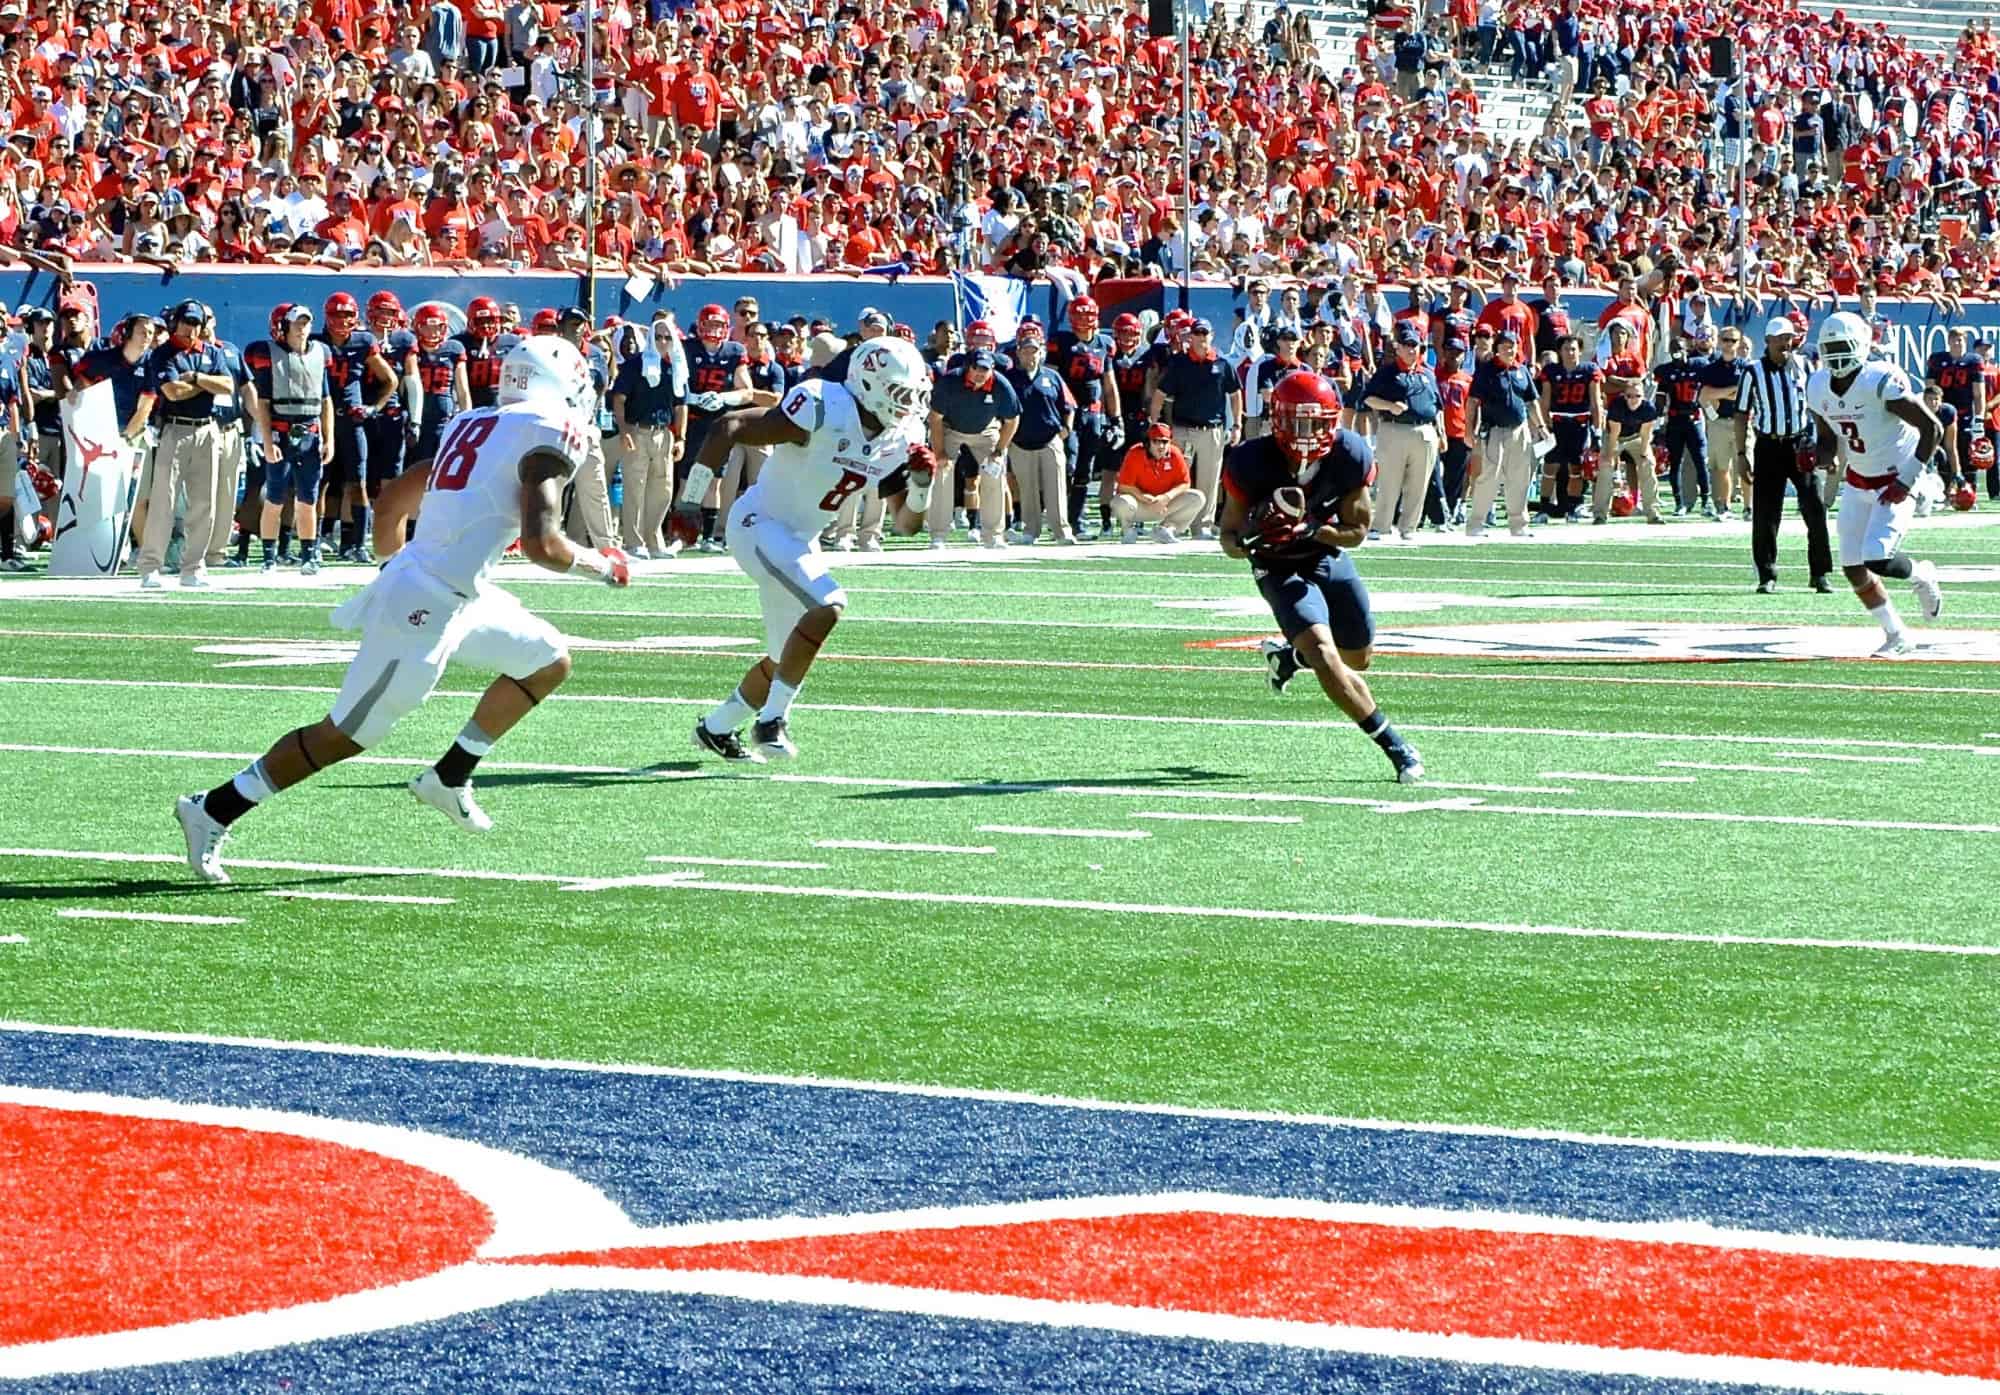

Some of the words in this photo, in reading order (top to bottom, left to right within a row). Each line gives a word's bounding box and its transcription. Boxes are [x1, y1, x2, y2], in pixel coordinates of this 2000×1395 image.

[786, 392, 807, 416] 8
[426, 415, 500, 492] 18
[1838, 421, 1867, 454] 3
[818, 467, 868, 512] 8
